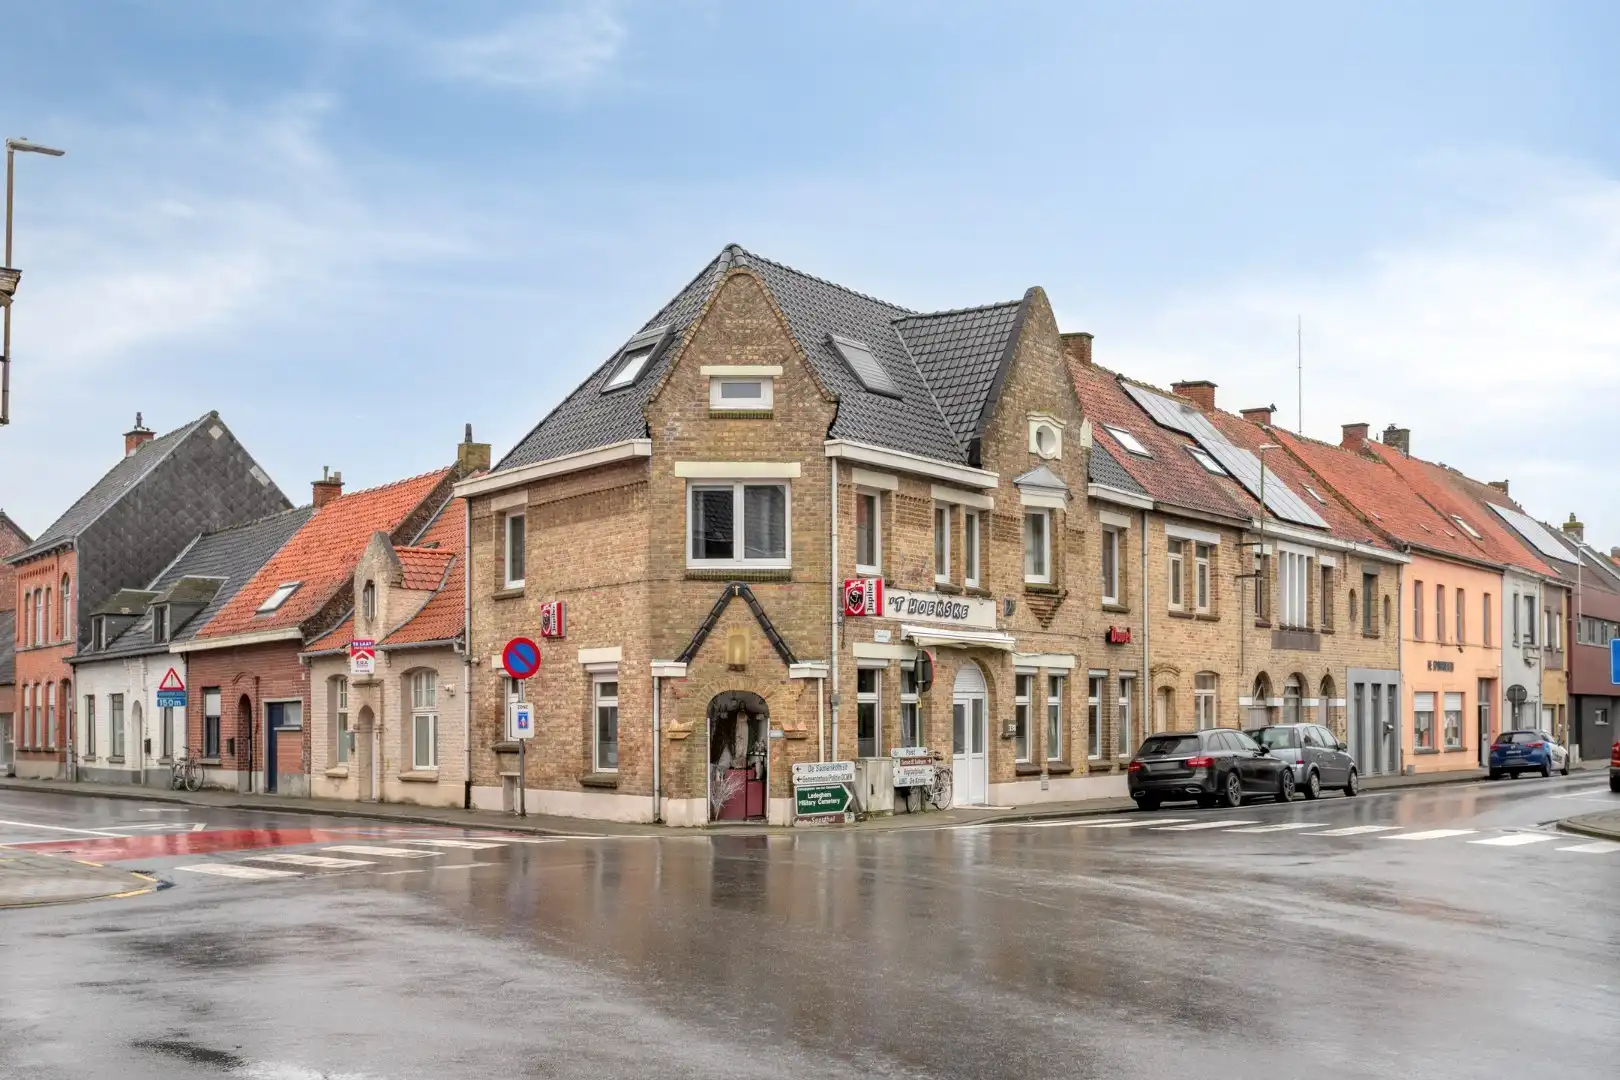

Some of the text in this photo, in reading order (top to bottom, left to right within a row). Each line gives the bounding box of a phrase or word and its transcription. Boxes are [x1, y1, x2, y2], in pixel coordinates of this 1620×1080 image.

[867, 580, 875, 612] Jupiler
[907, 598, 969, 619] HOEKSKE
[807, 764, 815, 773] De
[798, 799, 816, 807] Military
